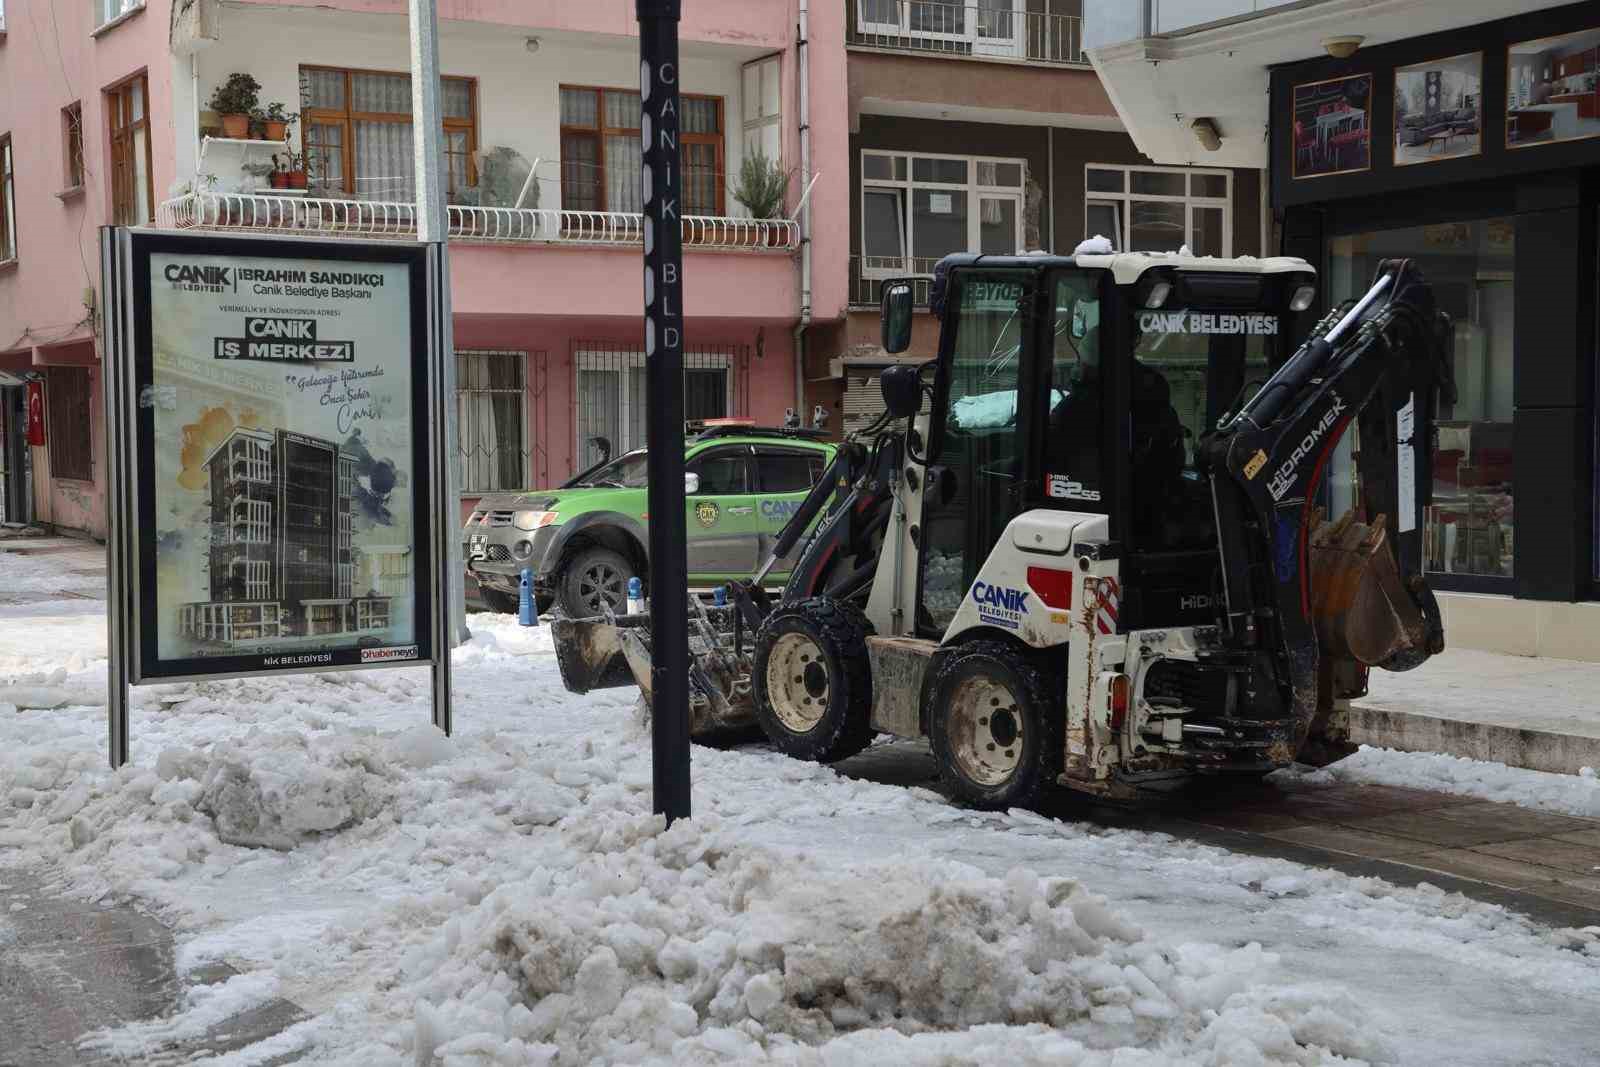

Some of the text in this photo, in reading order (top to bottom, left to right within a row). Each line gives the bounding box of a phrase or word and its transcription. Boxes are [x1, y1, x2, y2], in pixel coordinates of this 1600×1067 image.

[252, 283, 372, 300] Canik Belediye Başkanı
[662, 263, 679, 348] BLD
[761, 500, 803, 517] CAN
